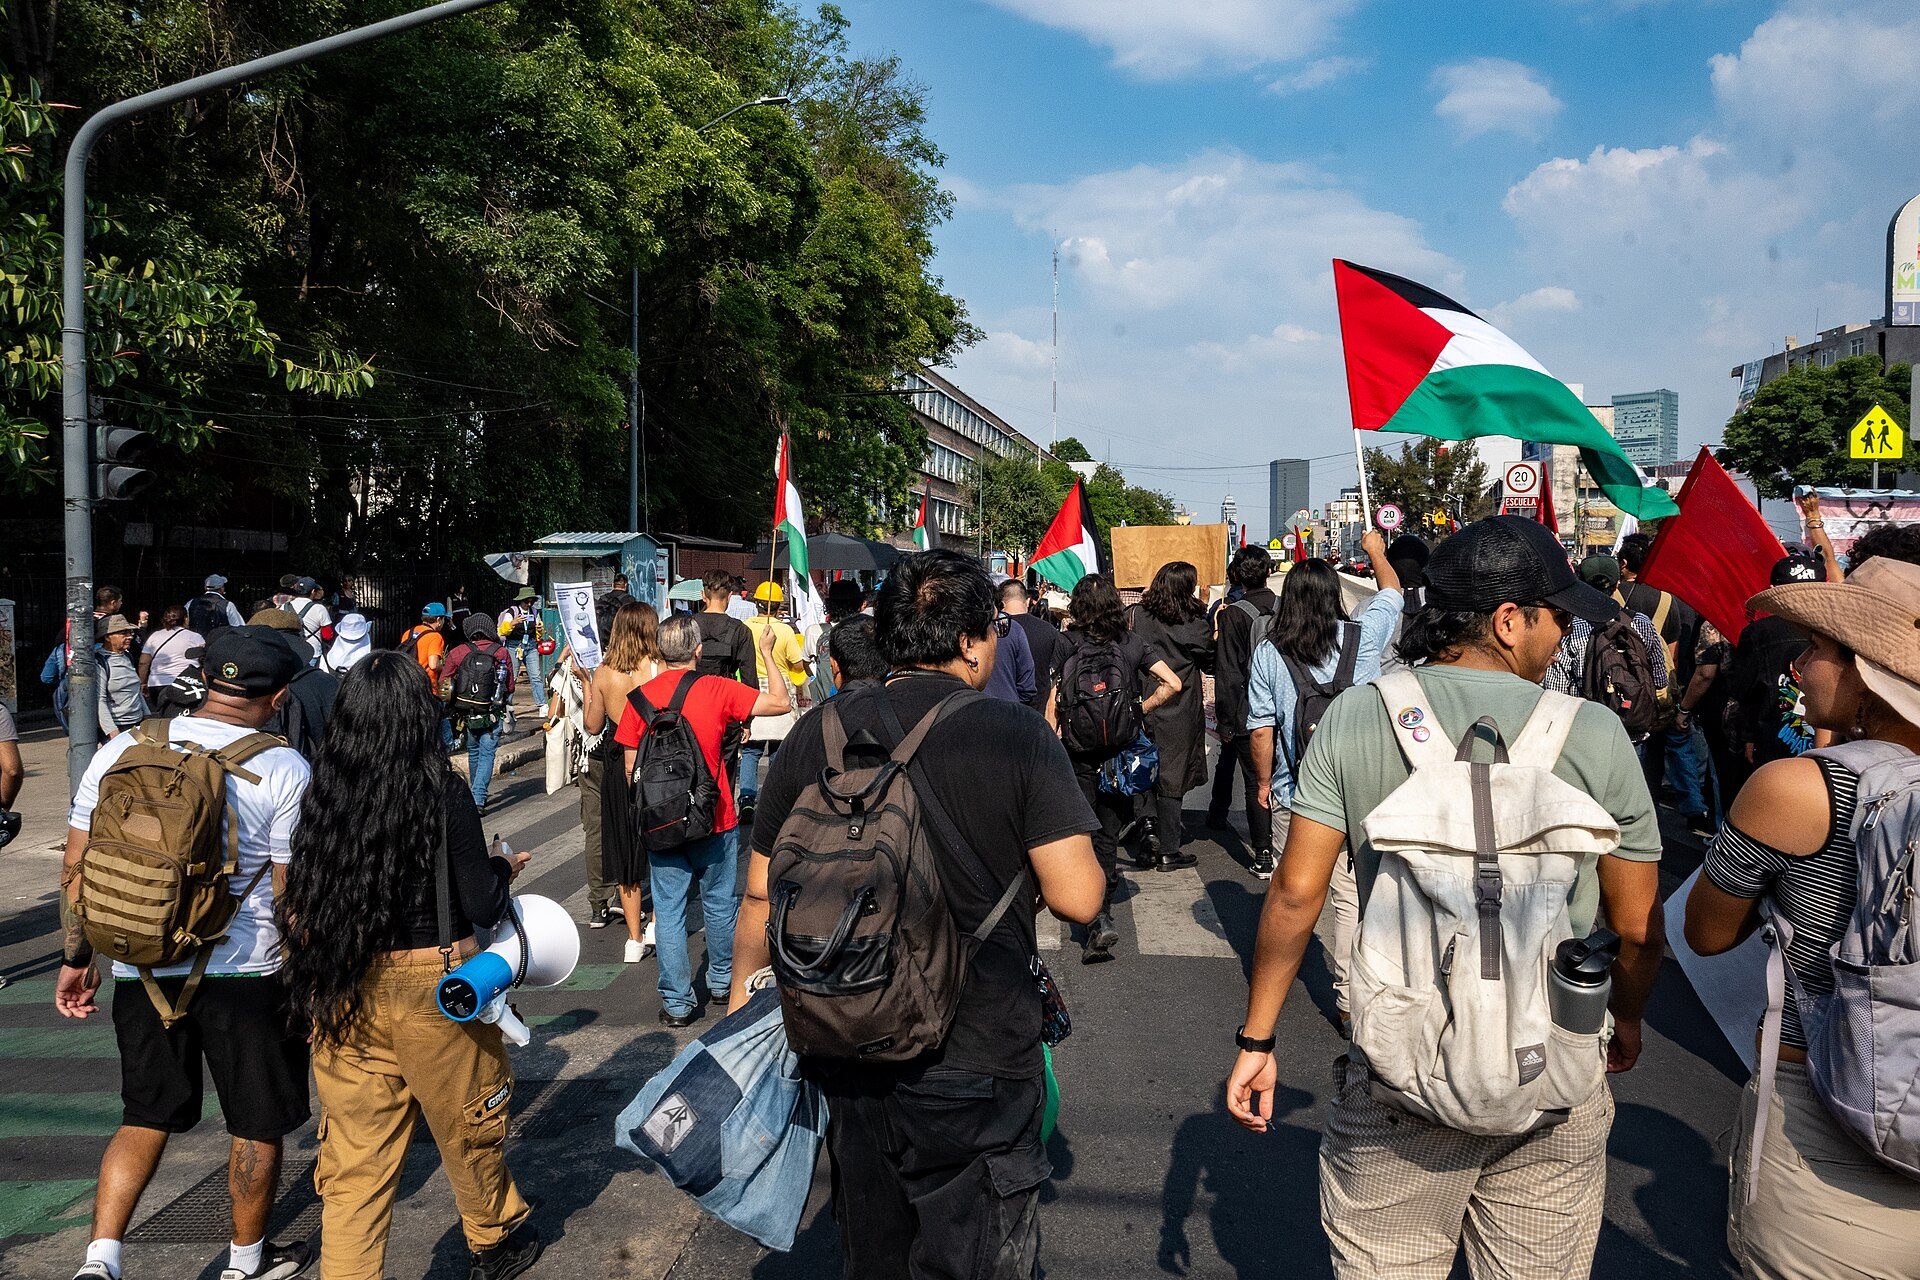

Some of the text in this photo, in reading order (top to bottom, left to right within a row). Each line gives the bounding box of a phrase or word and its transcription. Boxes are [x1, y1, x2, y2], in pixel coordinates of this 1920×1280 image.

[1514, 471, 1528, 482] 20
[1505, 497, 1536, 506] ESCUELA
[1383, 510, 1395, 519] 20
[1521, 1056, 1544, 1067] adidas
